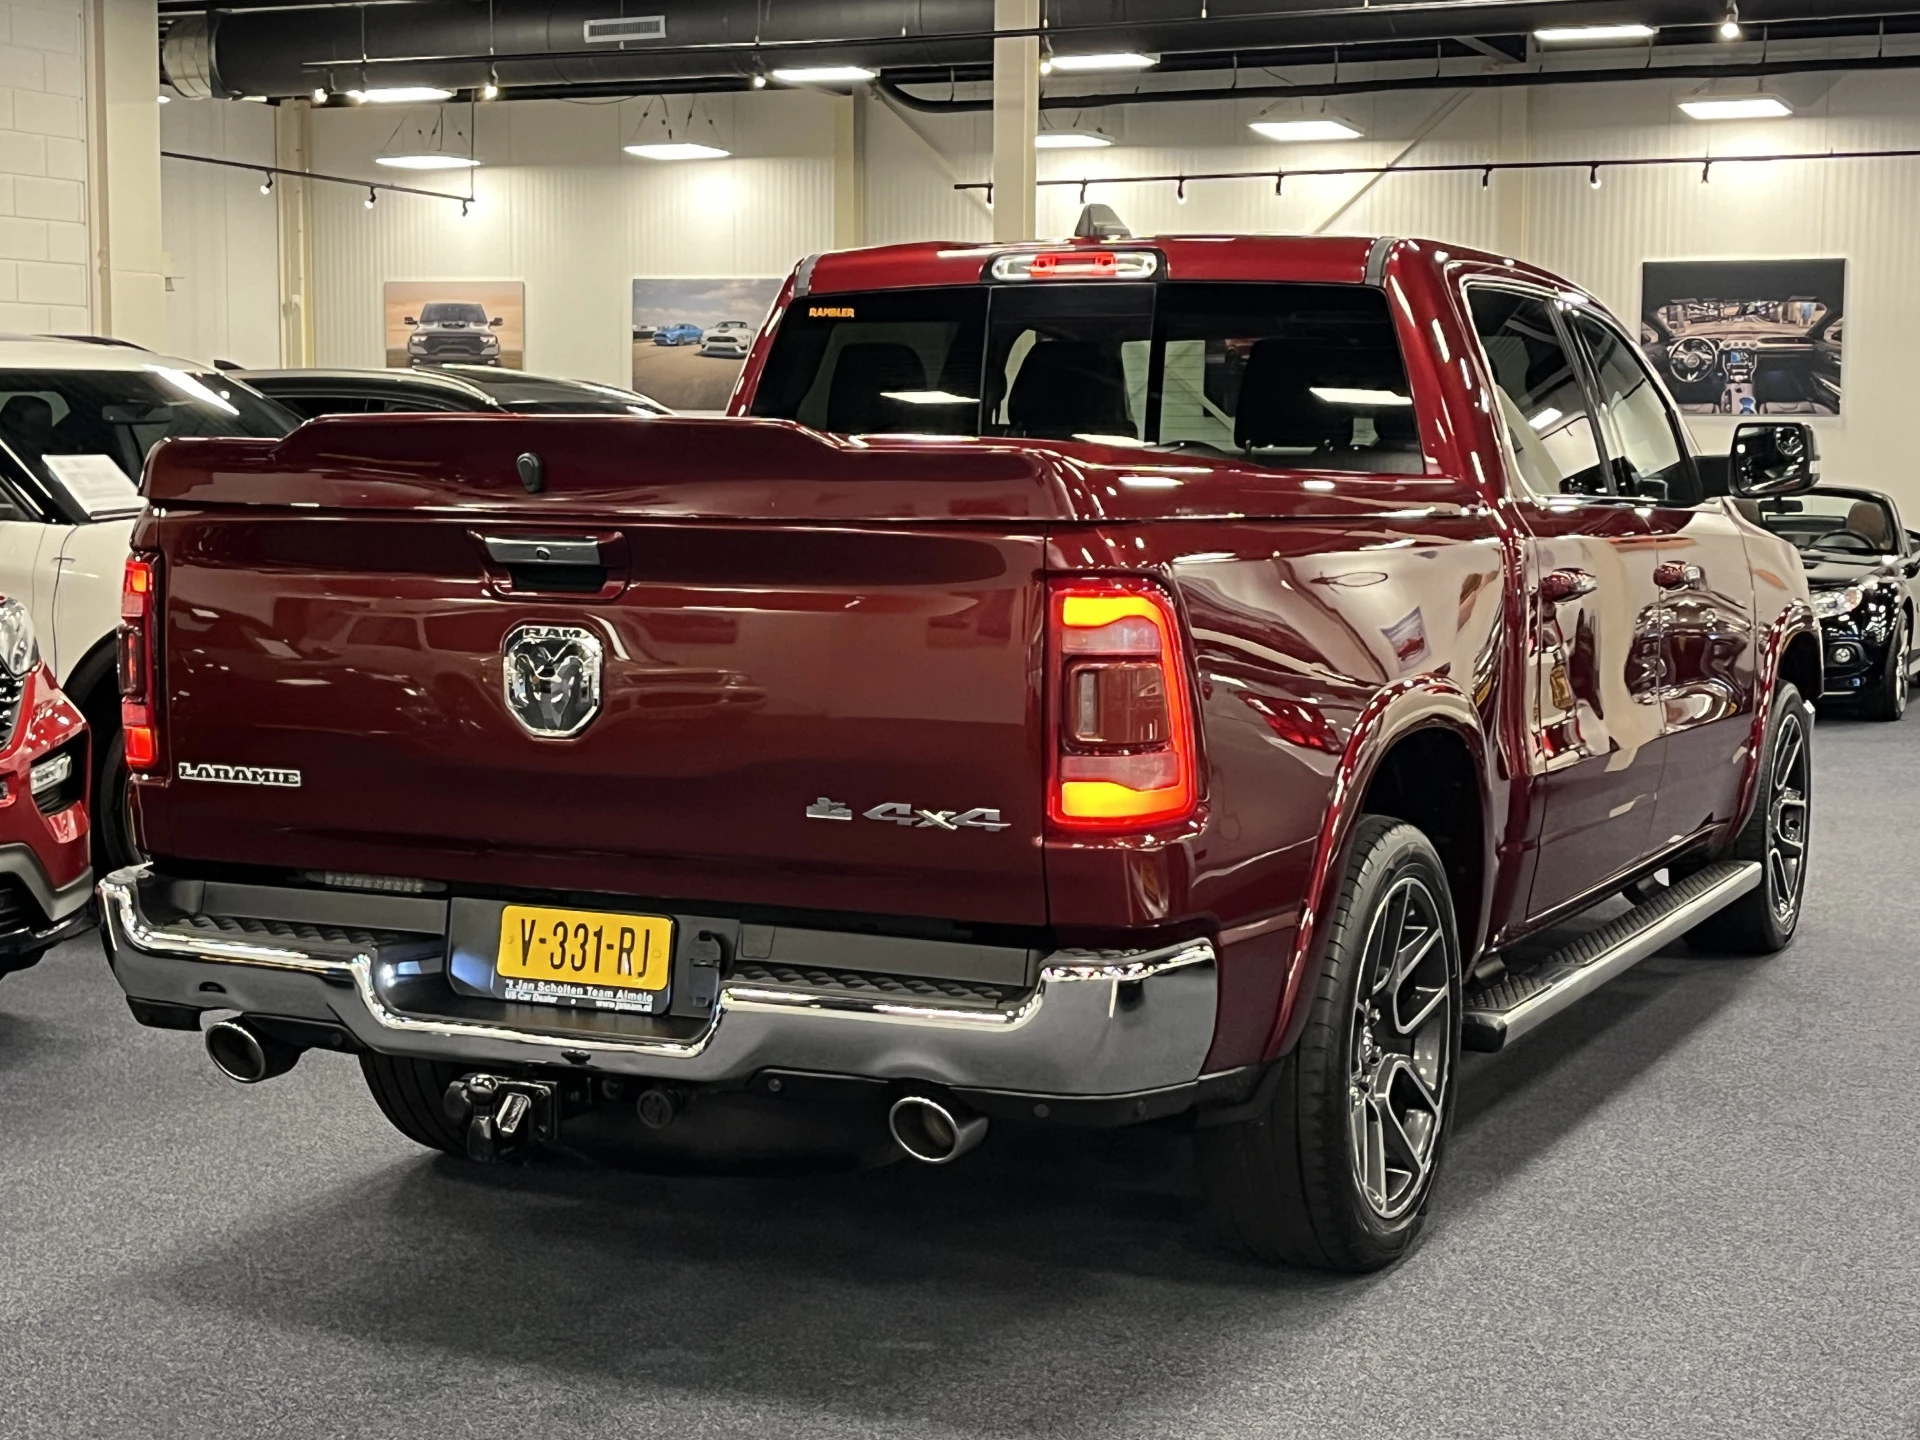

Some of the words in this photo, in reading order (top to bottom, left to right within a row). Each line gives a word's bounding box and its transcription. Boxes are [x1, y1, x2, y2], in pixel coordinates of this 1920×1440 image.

[524, 628, 582, 638] RAM
[178, 762, 301, 787] LARAMIE
[521, 918, 650, 978] V-331-RJ
[515, 980, 535, 991] Jan
[537, 981, 584, 996] Scholten
[586, 986, 614, 998] Team
[616, 989, 653, 1002] Almelo
